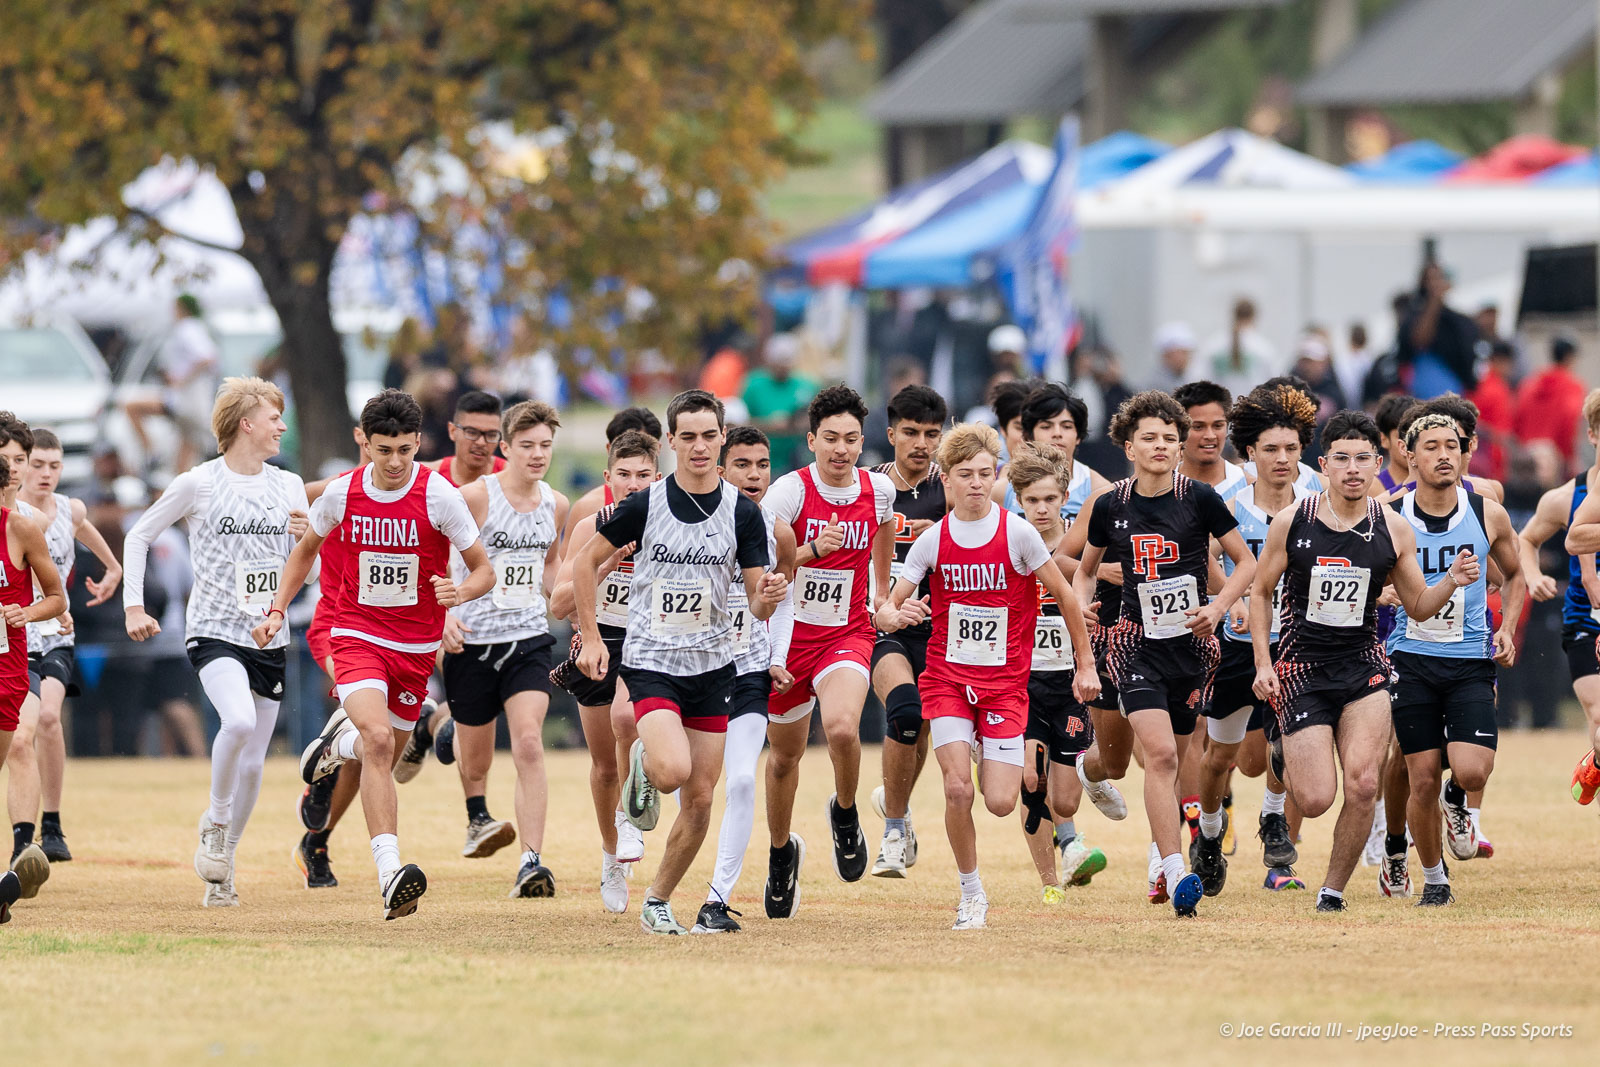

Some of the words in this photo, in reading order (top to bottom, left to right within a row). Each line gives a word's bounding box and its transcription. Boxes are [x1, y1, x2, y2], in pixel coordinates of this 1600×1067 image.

[217, 516, 288, 535] Bushland
[351, 514, 420, 547] FRIONA
[650, 543, 731, 566] Bushland
[246, 571, 278, 594] 820
[369, 565, 409, 585] 885
[504, 565, 534, 586] 821
[940, 562, 1008, 592] FRIONA
[605, 583, 630, 606] 92
[662, 592, 703, 614] 822
[803, 581, 843, 603] 884
[1150, 589, 1191, 615] 923
[1319, 580, 1360, 603] 922
[959, 618, 998, 642] 882
[1033, 629, 1063, 649] 26
